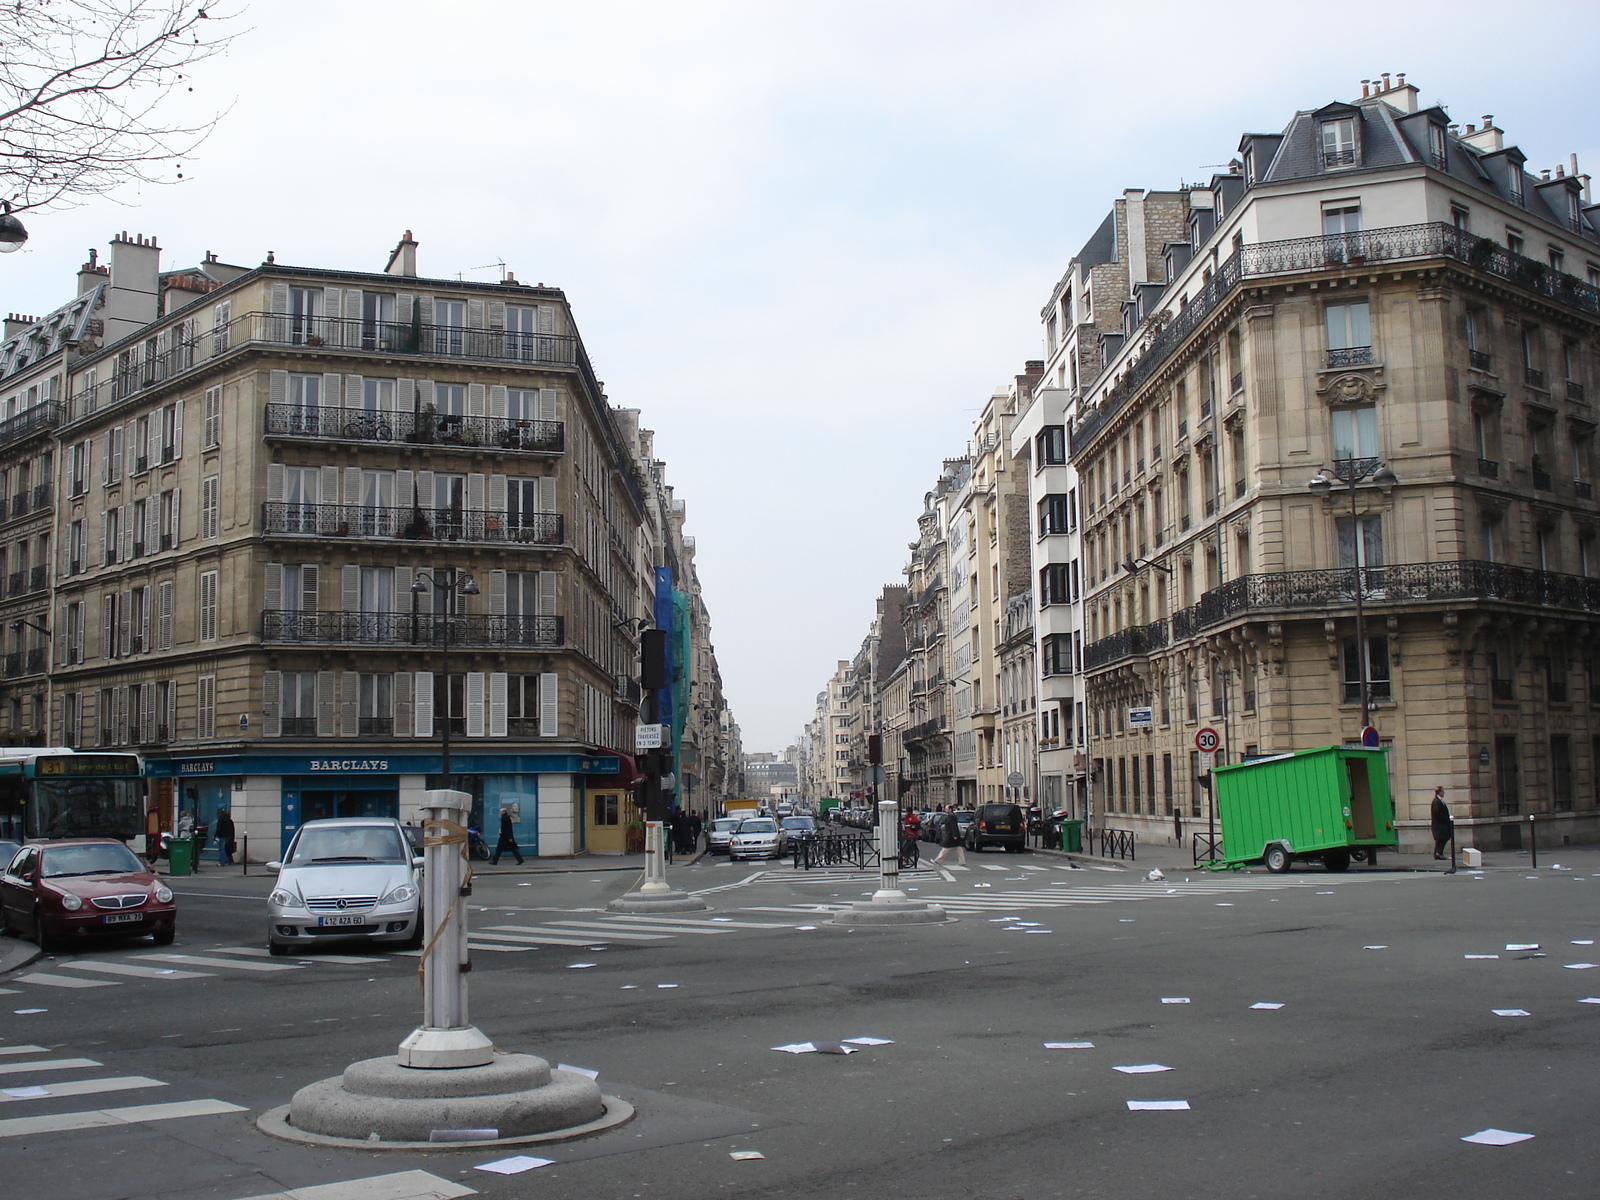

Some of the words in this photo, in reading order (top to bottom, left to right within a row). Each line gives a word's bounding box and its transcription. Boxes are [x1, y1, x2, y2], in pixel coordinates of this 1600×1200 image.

[1200, 735, 1216, 747] 30
[47, 761, 62, 773] 31
[181, 762, 214, 773] BARCLAYS
[310, 760, 388, 771] BARCLAYS
[134, 912, 143, 920] 75
[324, 917, 337, 925] 412
[338, 917, 352, 925] AZA
[353, 916, 362, 925] 60
